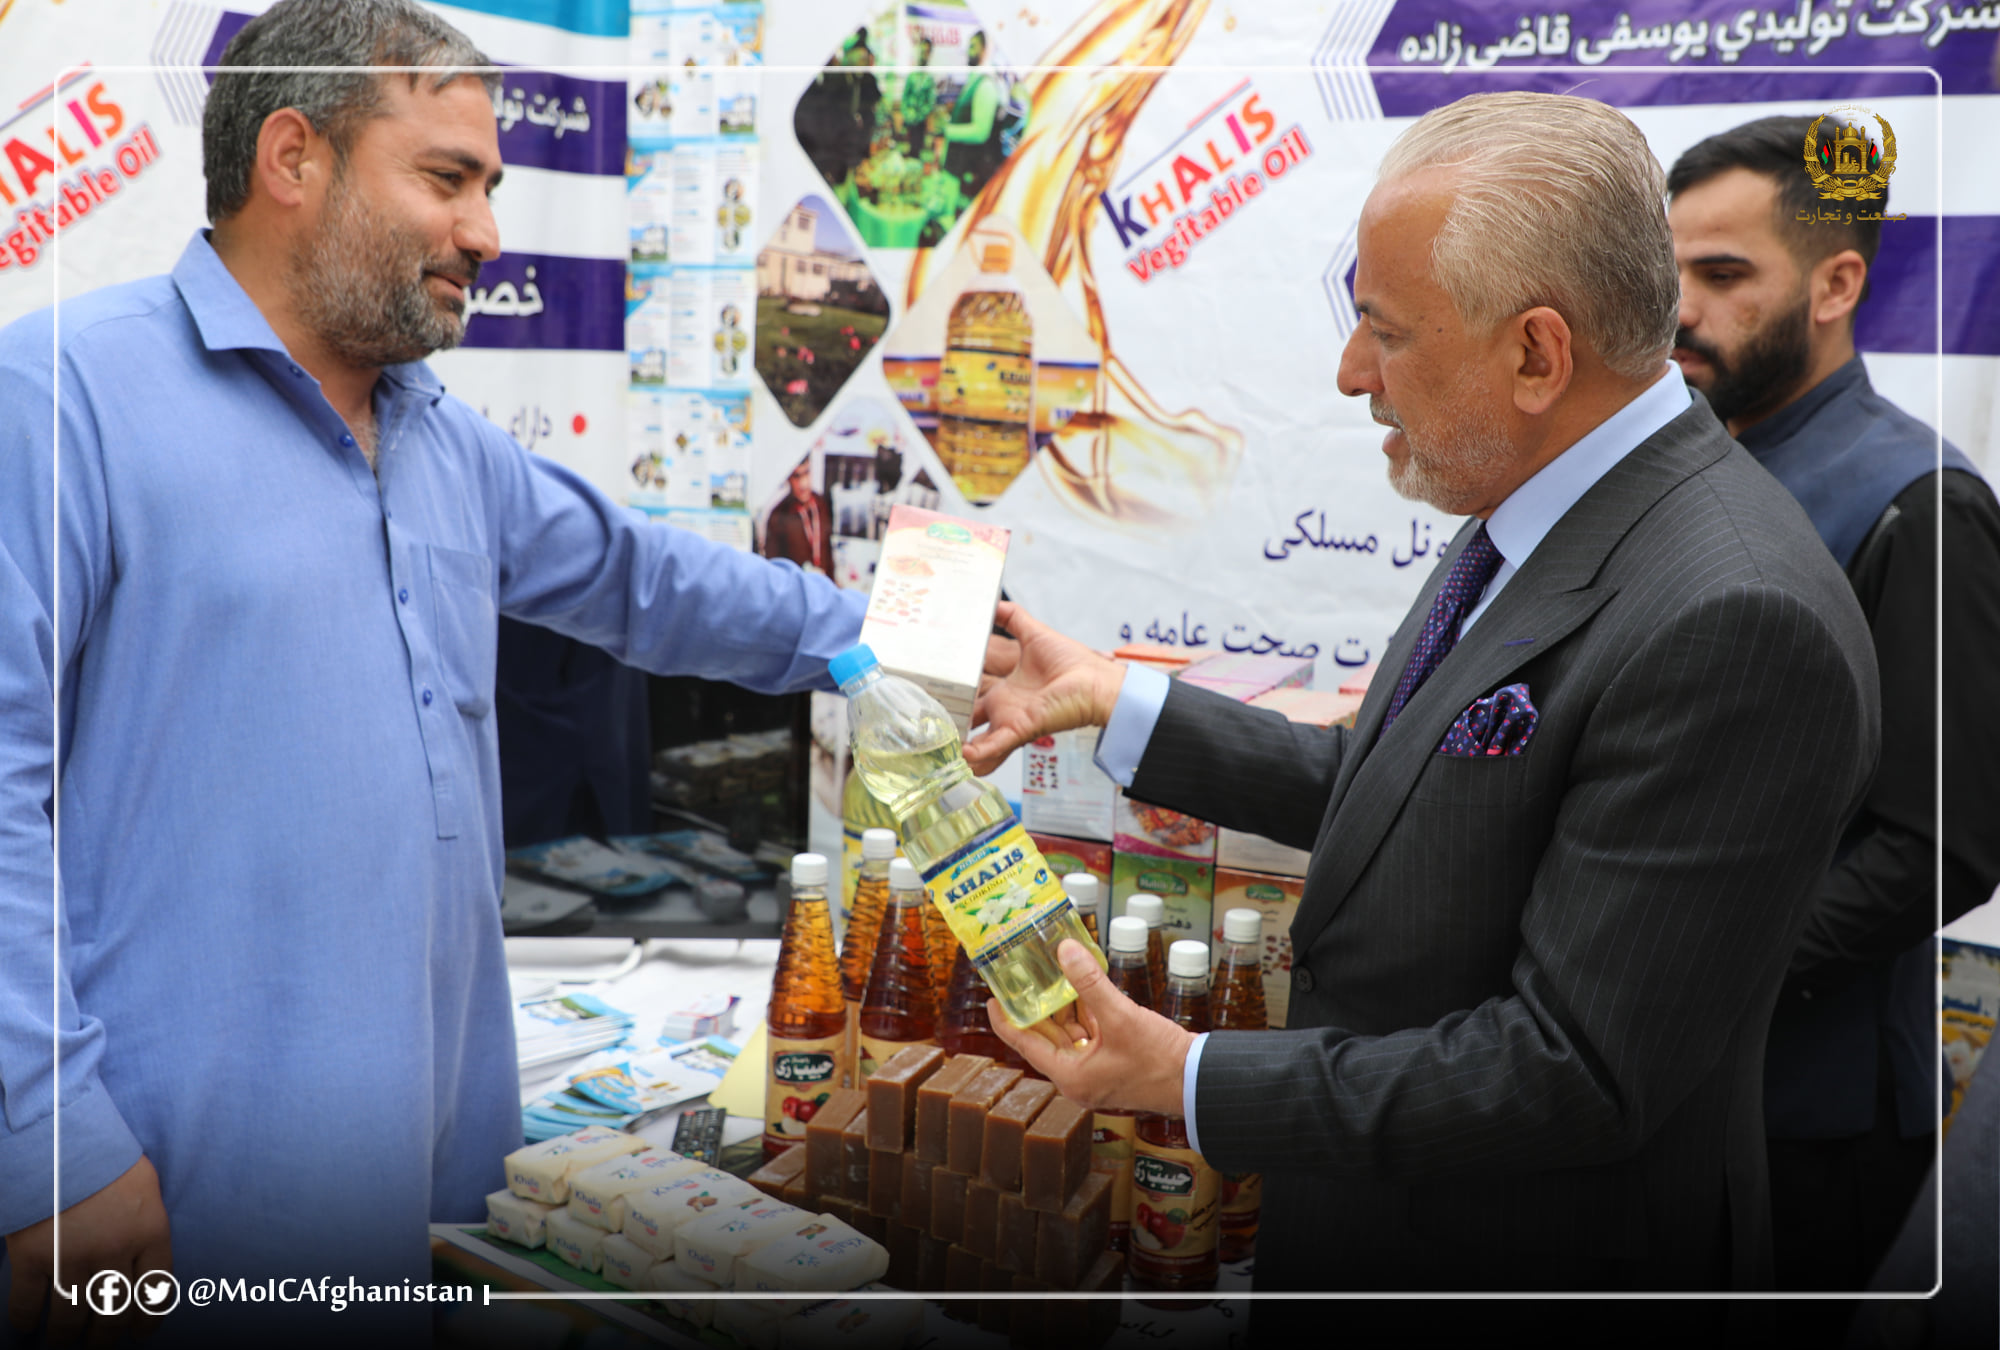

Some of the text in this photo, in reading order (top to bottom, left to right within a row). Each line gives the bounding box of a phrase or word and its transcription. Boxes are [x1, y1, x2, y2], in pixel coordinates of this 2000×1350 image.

[0, 82, 124, 205] ALIS
[526, 97, 591, 139] شرکت
[0, 123, 160, 269] egitable Oil
[1125, 125, 1313, 284] Vegitable Oil
[1263, 508, 1379, 560] مسلکی
[1120, 622, 1132, 643] و
[1144, 611, 1208, 647] عامه
[1222, 624, 1319, 659] صحت
[944, 847, 1024, 904] KHALIS
